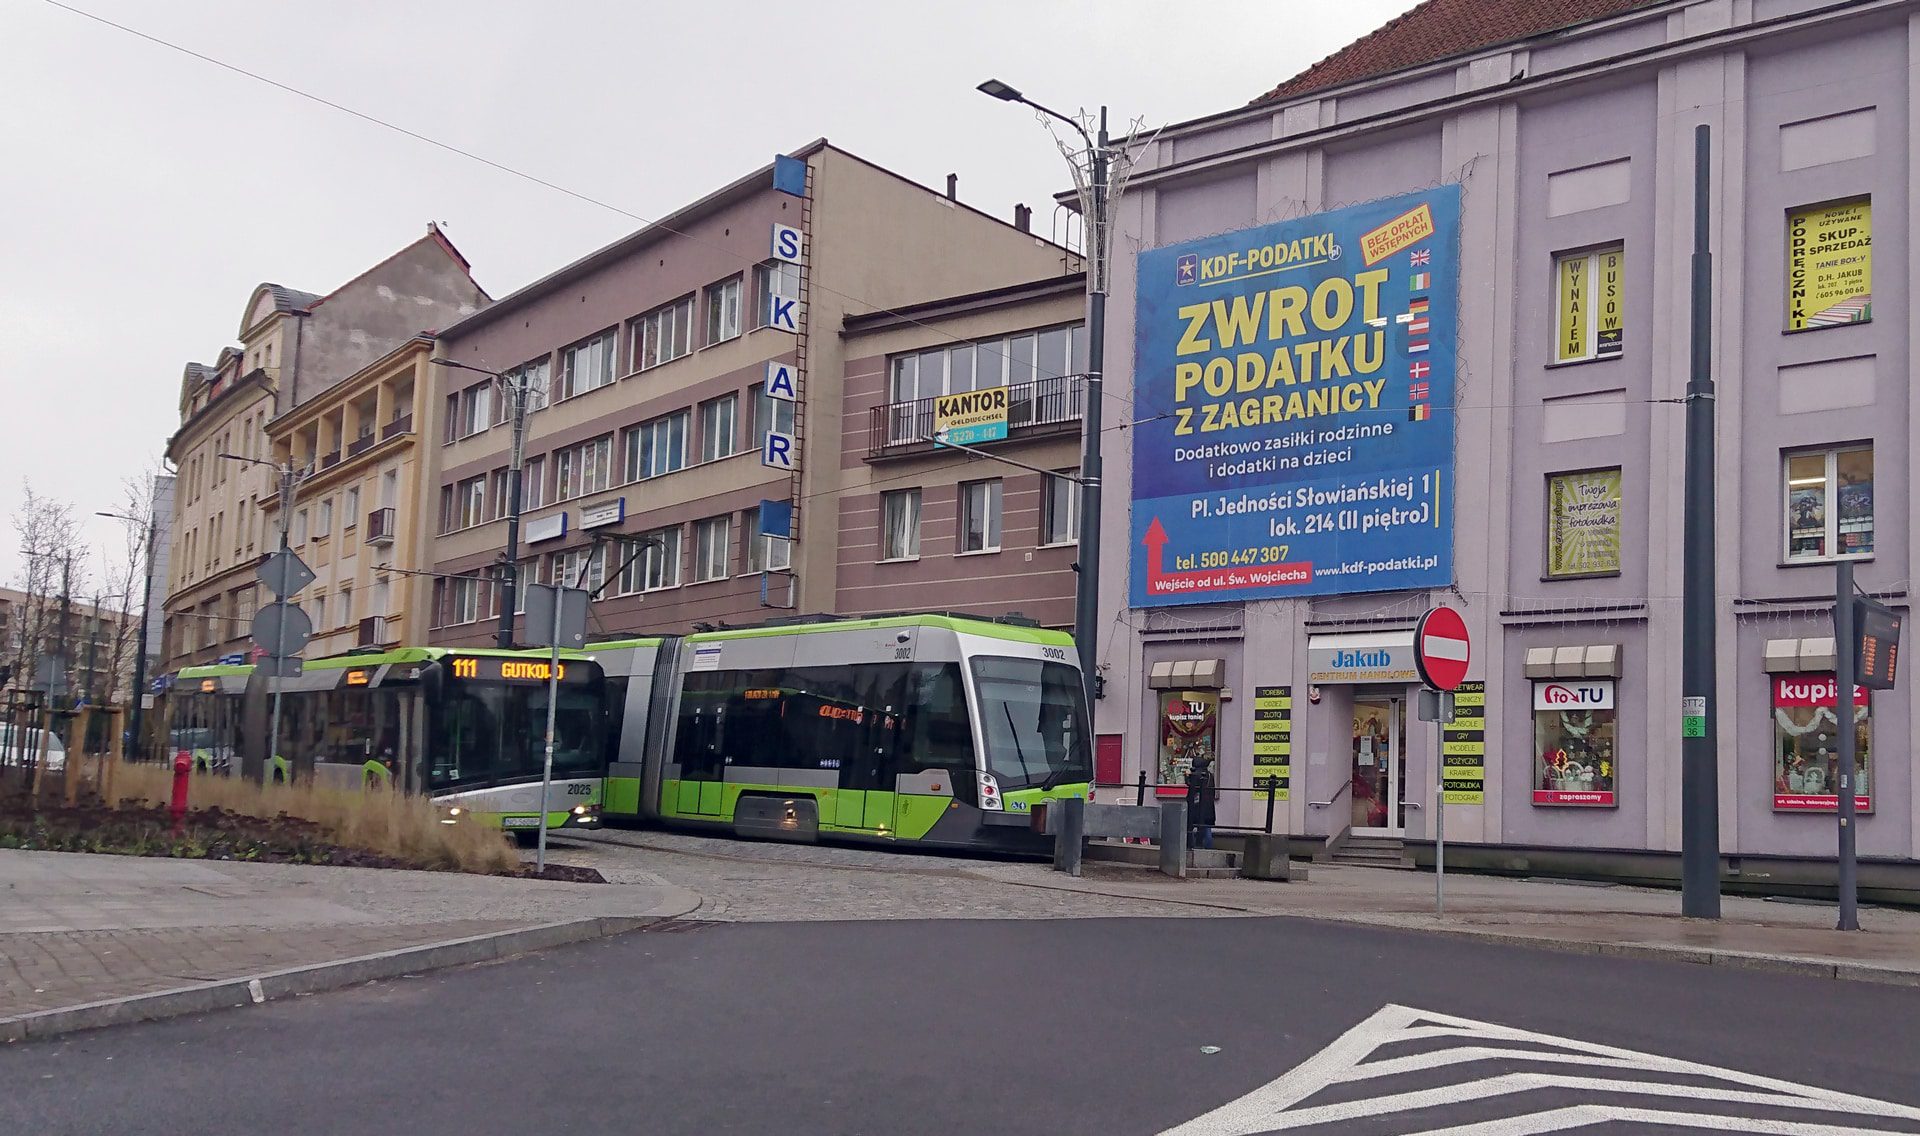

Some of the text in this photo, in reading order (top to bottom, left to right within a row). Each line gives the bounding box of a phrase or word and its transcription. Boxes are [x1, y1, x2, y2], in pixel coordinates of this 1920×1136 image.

[1825, 209, 1850, 219] NOWE
[1367, 212, 1424, 249] BEZ OPŁAT
[1369, 222, 1428, 258] WSTĘPNYCH
[1818, 227, 1857, 242] SKUP
[1809, 235, 1872, 256] SPRZEDAŻ
[1200, 232, 1334, 281] KDF-PODATKI
[1815, 255, 1866, 269] TANIE BOX-Y
[1792, 217, 1806, 328] PODRĘCZNIKI
[1818, 268, 1863, 283] D.H. JAKUB
[1604, 255, 1618, 330] BUSÓW
[1820, 289, 1834, 299] 605
[1834, 288, 1844, 296] 96
[1855, 285, 1865, 293] 60
[1175, 267, 1390, 358] ZWROT
[1568, 261, 1581, 355] WYNAJEM
[1174, 329, 1386, 404] PODATKU
[938, 390, 1006, 418] KANTOR
[1174, 378, 1387, 437] Z ZAGRANICY
[950, 413, 1004, 426] GELDWECHSEL
[1174, 422, 1393, 462] Dodatkowo zasiłki rodzinne
[1209, 447, 1352, 479] i dodatki na dzieci
[1191, 474, 1430, 519] Pl. Jedności Słowiańskiej 1
[1578, 484, 1607, 499] Twoja
[1567, 500, 1617, 515] imprezowa
[1269, 517, 1301, 538] lok.
[1304, 514, 1335, 535] 214
[1362, 502, 1430, 533] piętro)
[1569, 513, 1616, 528] fotobudka
[1176, 545, 1289, 571] tel. 500 447 307
[1315, 555, 1438, 578] www.kdf-podatki.pl
[1155, 568, 1307, 592] Wejście od ul. Św. Wojciecha
[1042, 645, 1066, 661] 3002
[1332, 648, 1391, 668] Jakub
[452, 658, 477, 678] 111
[1310, 669, 1416, 681] CENTRUM HANDLOWE
[1578, 687, 1603, 703] TU
[1780, 679, 1862, 703] kupiz
[1189, 702, 1205, 713] TU
[1687, 727, 1698, 736] 36
[1449, 744, 1476, 752] MODELE
[1259, 756, 1283, 764] PERFUMY
[1449, 769, 1475, 777] KRAWIEC
[1444, 781, 1480, 789] FOTOBUDKA
[1445, 793, 1479, 801] FOTOGRAF
[1559, 794, 1602, 802] zapraszamy
